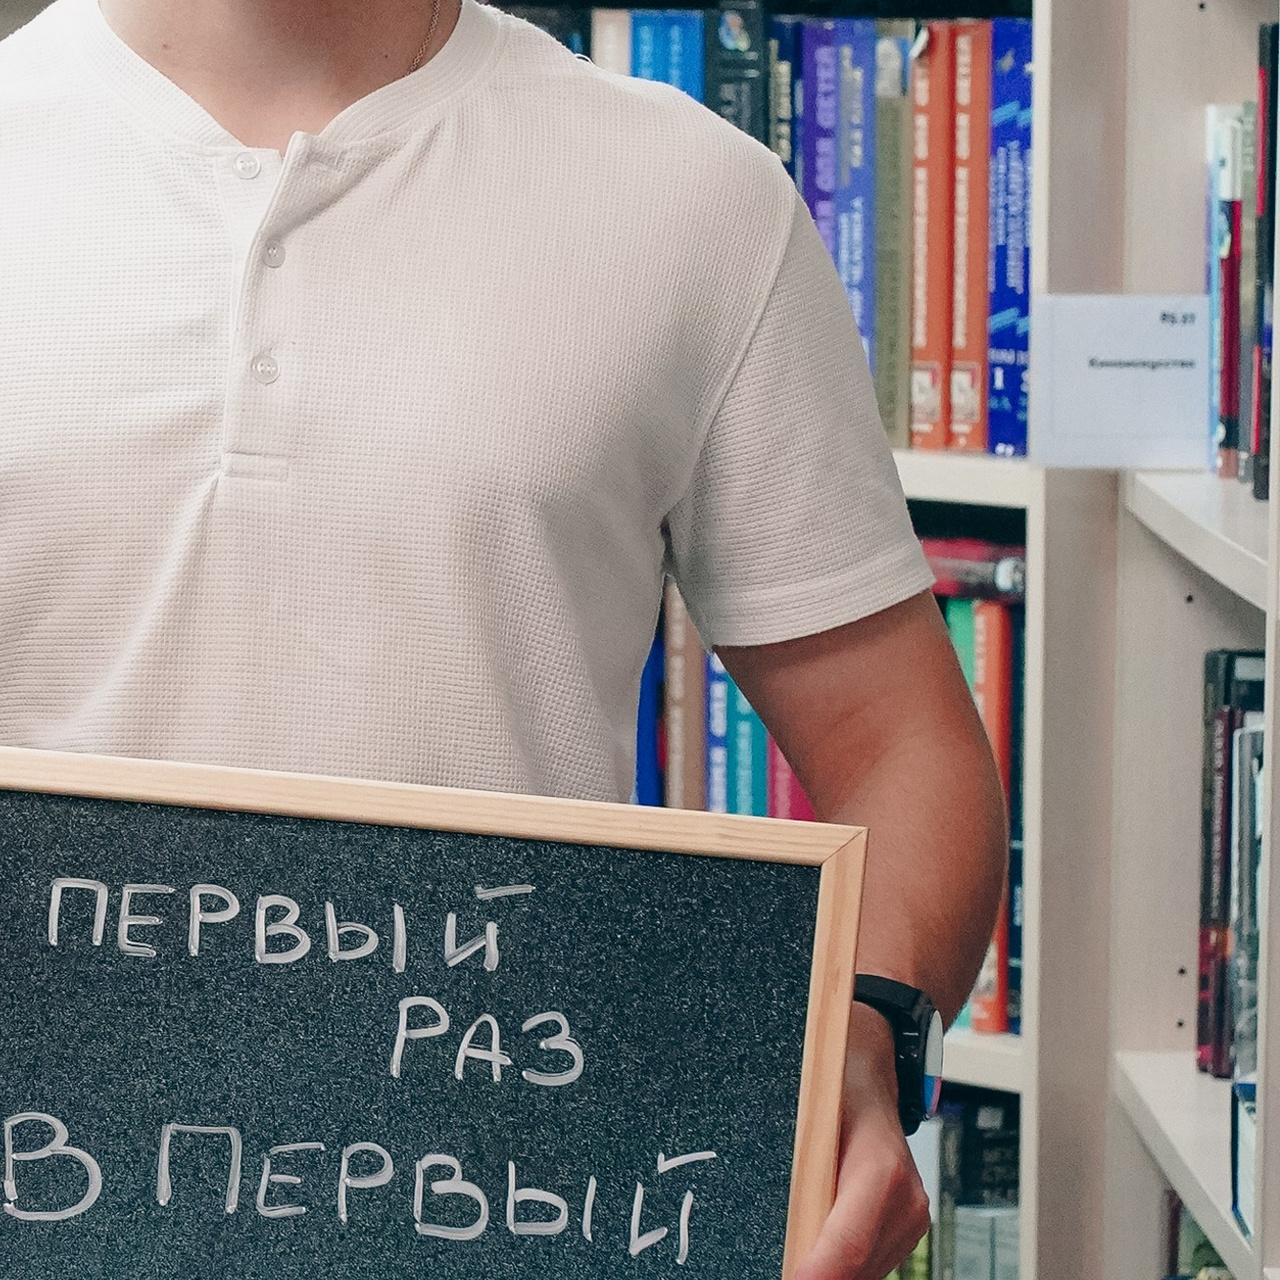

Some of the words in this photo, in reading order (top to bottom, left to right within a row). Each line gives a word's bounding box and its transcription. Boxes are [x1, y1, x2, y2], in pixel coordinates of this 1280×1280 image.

[48, 877, 536, 973] ПЕРВЫЙ
[390, 996, 584, 1086] РАЗ
[3, 1111, 103, 1221] В
[157, 1122, 717, 1265] ПЕРВЫЙ
